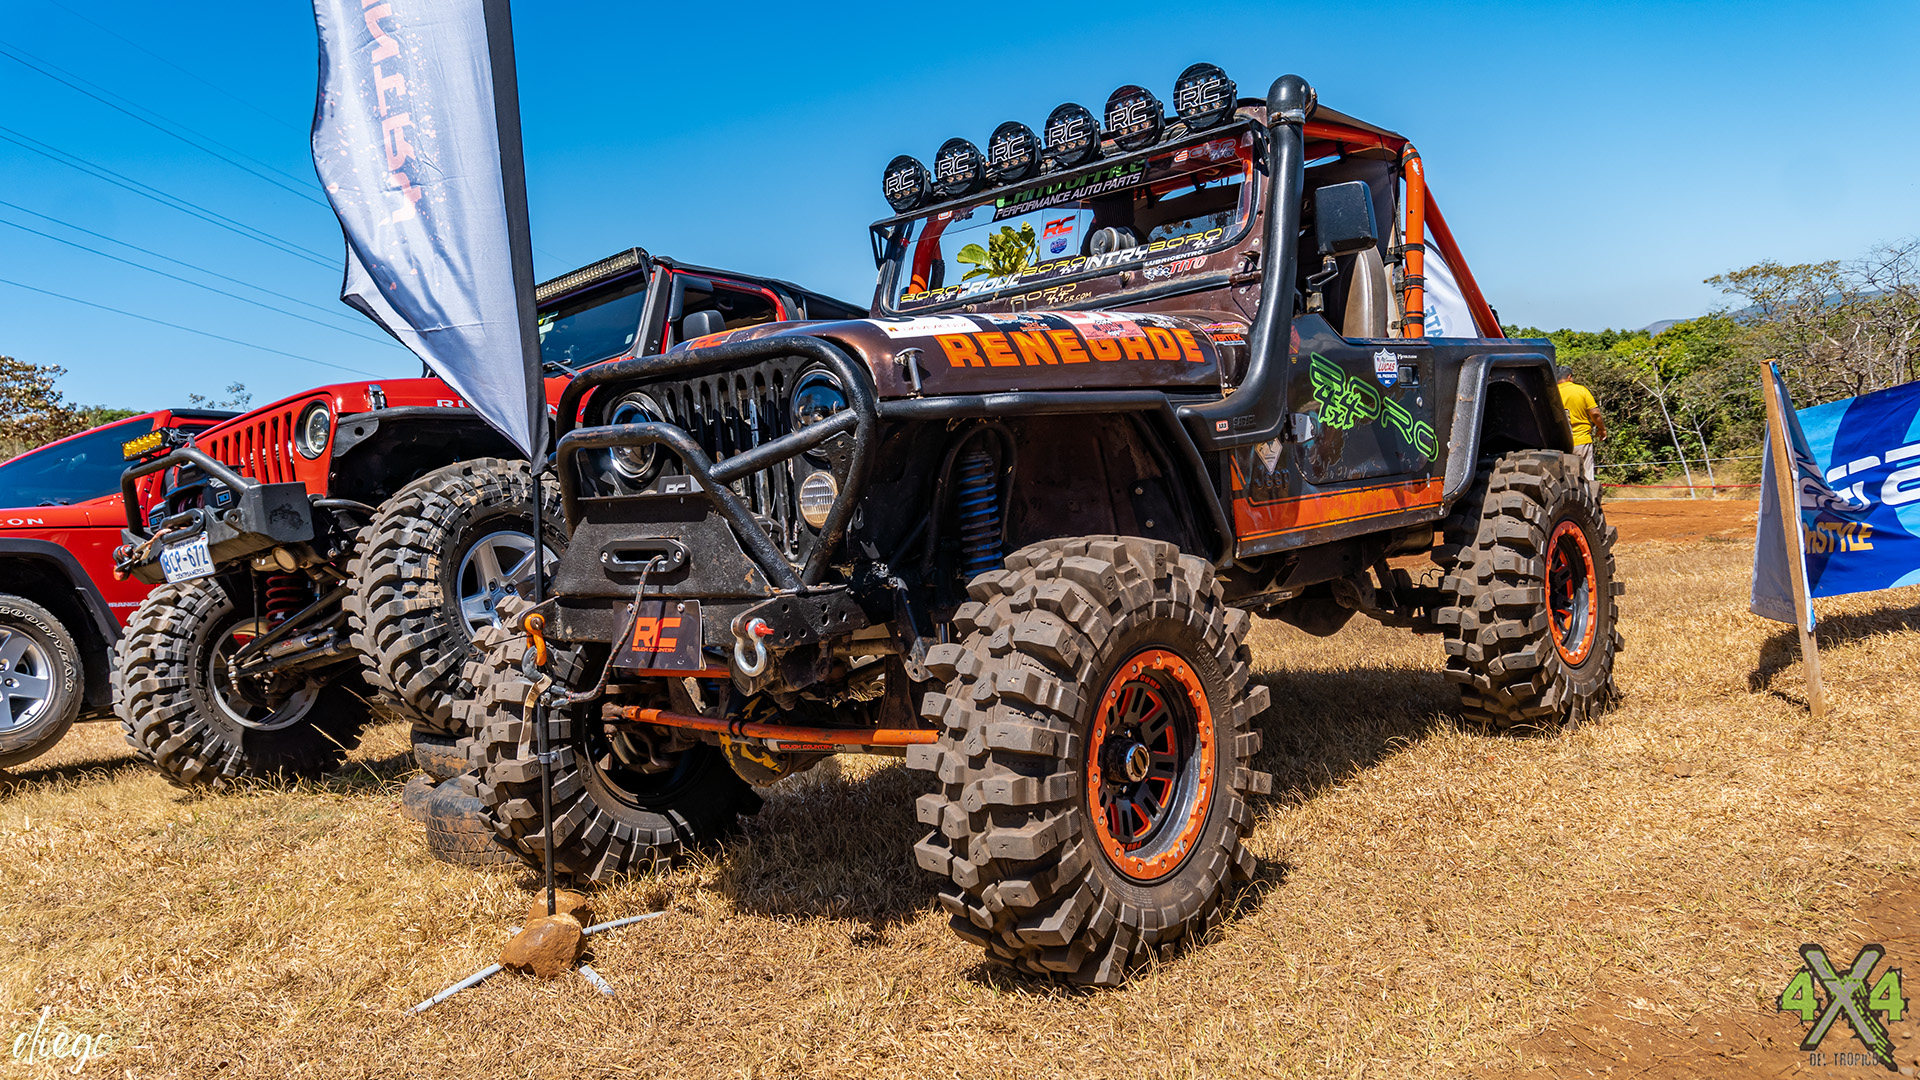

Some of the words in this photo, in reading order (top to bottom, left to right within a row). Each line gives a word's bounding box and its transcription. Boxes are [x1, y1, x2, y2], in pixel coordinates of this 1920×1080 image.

[1179, 79, 1221, 111] RC
[1110, 100, 1147, 132] RC
[1049, 117, 1084, 147] RC
[992, 135, 1025, 165] RC
[938, 152, 970, 179] RC
[886, 168, 915, 196] RC
[995, 191, 1071, 219] PERFORMANCE
[1071, 182, 1102, 200] AUTO
[1101, 172, 1141, 192] PARTS
[1043, 215, 1076, 237] RC
[1149, 228, 1223, 252] BORO
[1022, 256, 1086, 276] BORO
[1170, 255, 1208, 275] TITO
[901, 284, 960, 302] BORO
[934, 327, 1205, 368] RENEGADE
[1209, 333, 1244, 341] VERTEX
[1378, 363, 1396, 371] LUCAS
[1254, 464, 1291, 490] Jeep
[163, 544, 209, 574] BCP-672
[632, 617, 682, 647] RC
